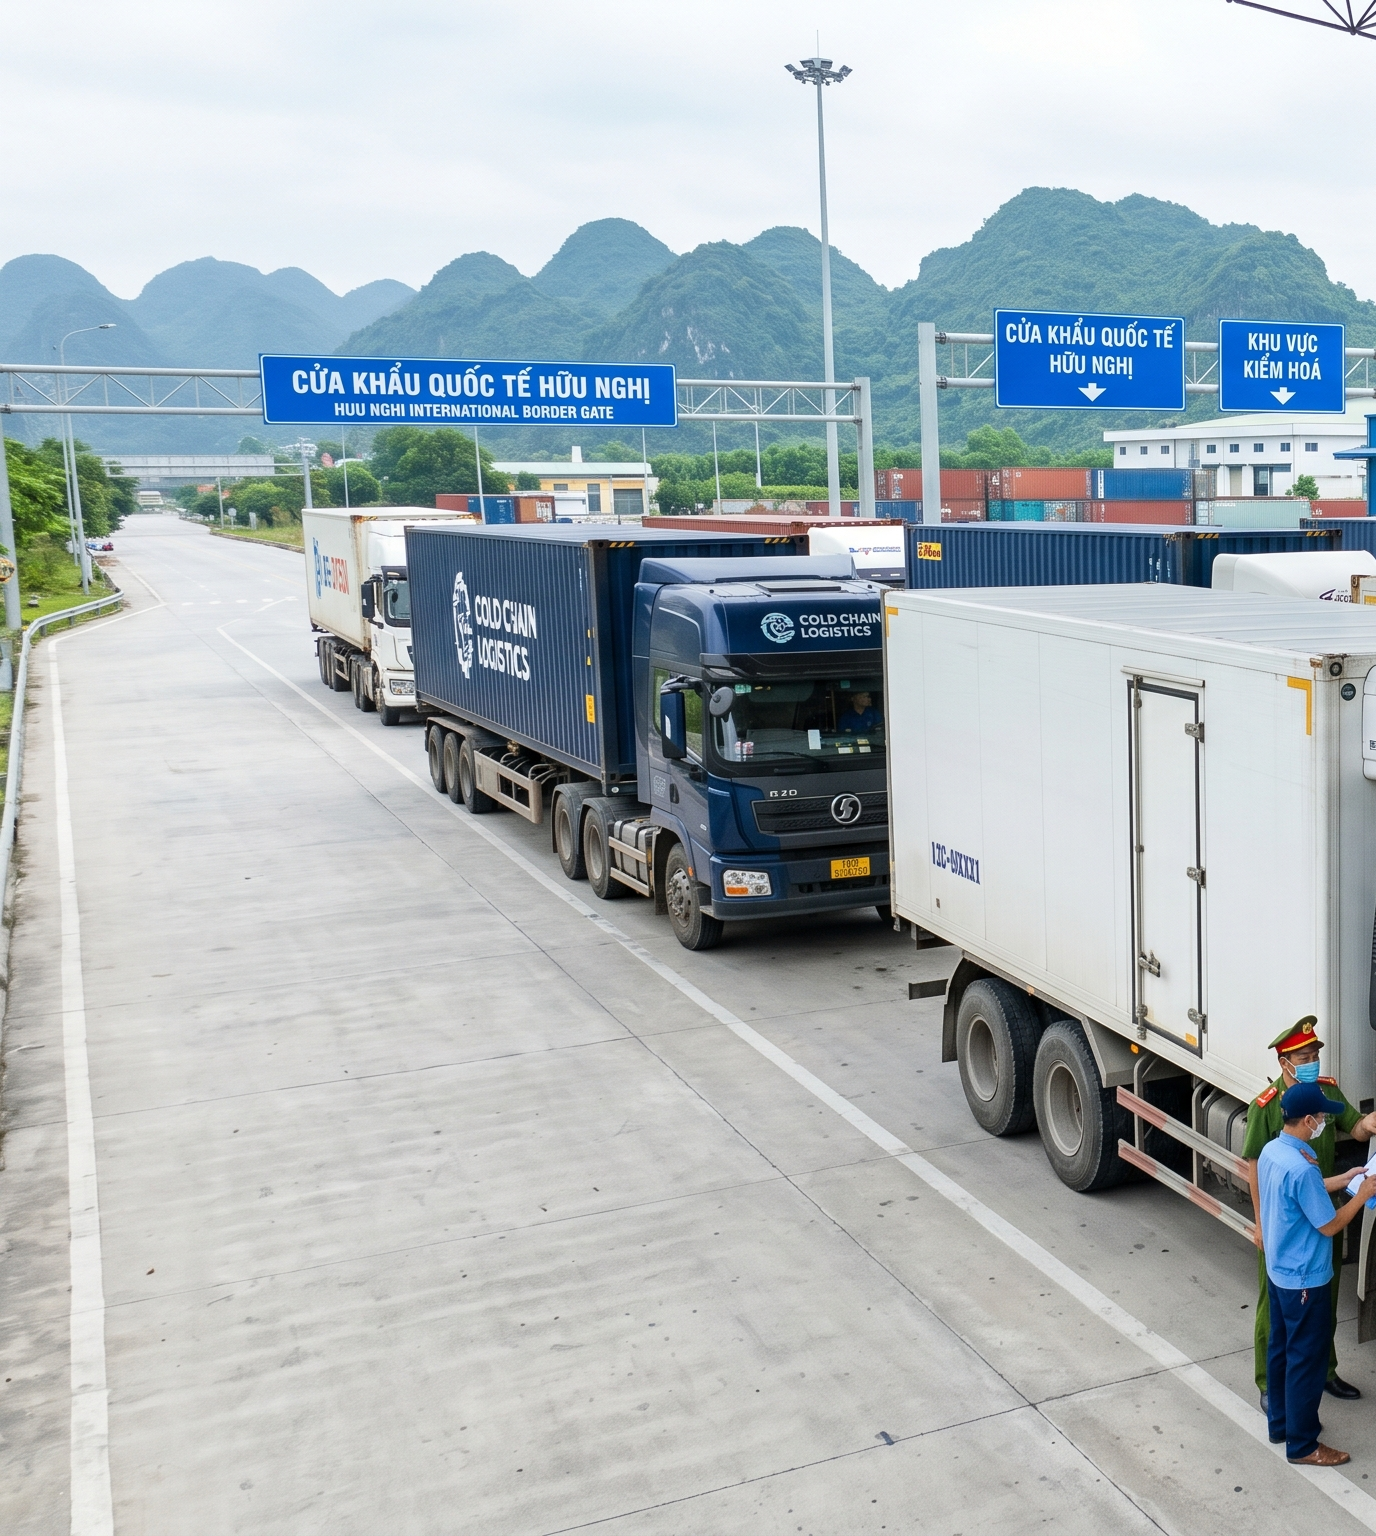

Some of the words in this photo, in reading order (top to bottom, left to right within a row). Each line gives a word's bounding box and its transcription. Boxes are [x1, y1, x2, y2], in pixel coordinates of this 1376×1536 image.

[1005, 317, 1043, 344] CỬA
[1047, 317, 1096, 346] KHẨU
[1101, 320, 1148, 348] QUỐC
[1152, 322, 1176, 349] TẾ
[1248, 332, 1281, 352] KHU
[1285, 332, 1318, 357] VỰC
[1050, 351, 1086, 374] HỮU
[1092, 355, 1133, 380] NGHỊ
[1243, 352, 1283, 379] KIỂM
[1288, 357, 1322, 380] HOÁ
[292, 363, 346, 394] CỬA
[352, 361, 421, 396] KHẨU
[428, 364, 496, 398] QUỐC
[501, 366, 534, 398] TẾ
[539, 370, 587, 399] HỮU
[595, 376, 650, 405] NGHỊ
[334, 402, 366, 417] HUU
[369, 403, 406, 418] NGHI
[409, 404, 519, 419] INTERNATIONAL
[522, 405, 578, 420] BORDER
[580, 406, 614, 420] GATE
[475, 594, 502, 630] COLD
[503, 599, 537, 640] CHAIN
[799, 614, 838, 626] COLD
[839, 612, 881, 624] CHAIN
[800, 625, 872, 638] LOGISTICS
[476, 634, 531, 681] LOGISTICS
